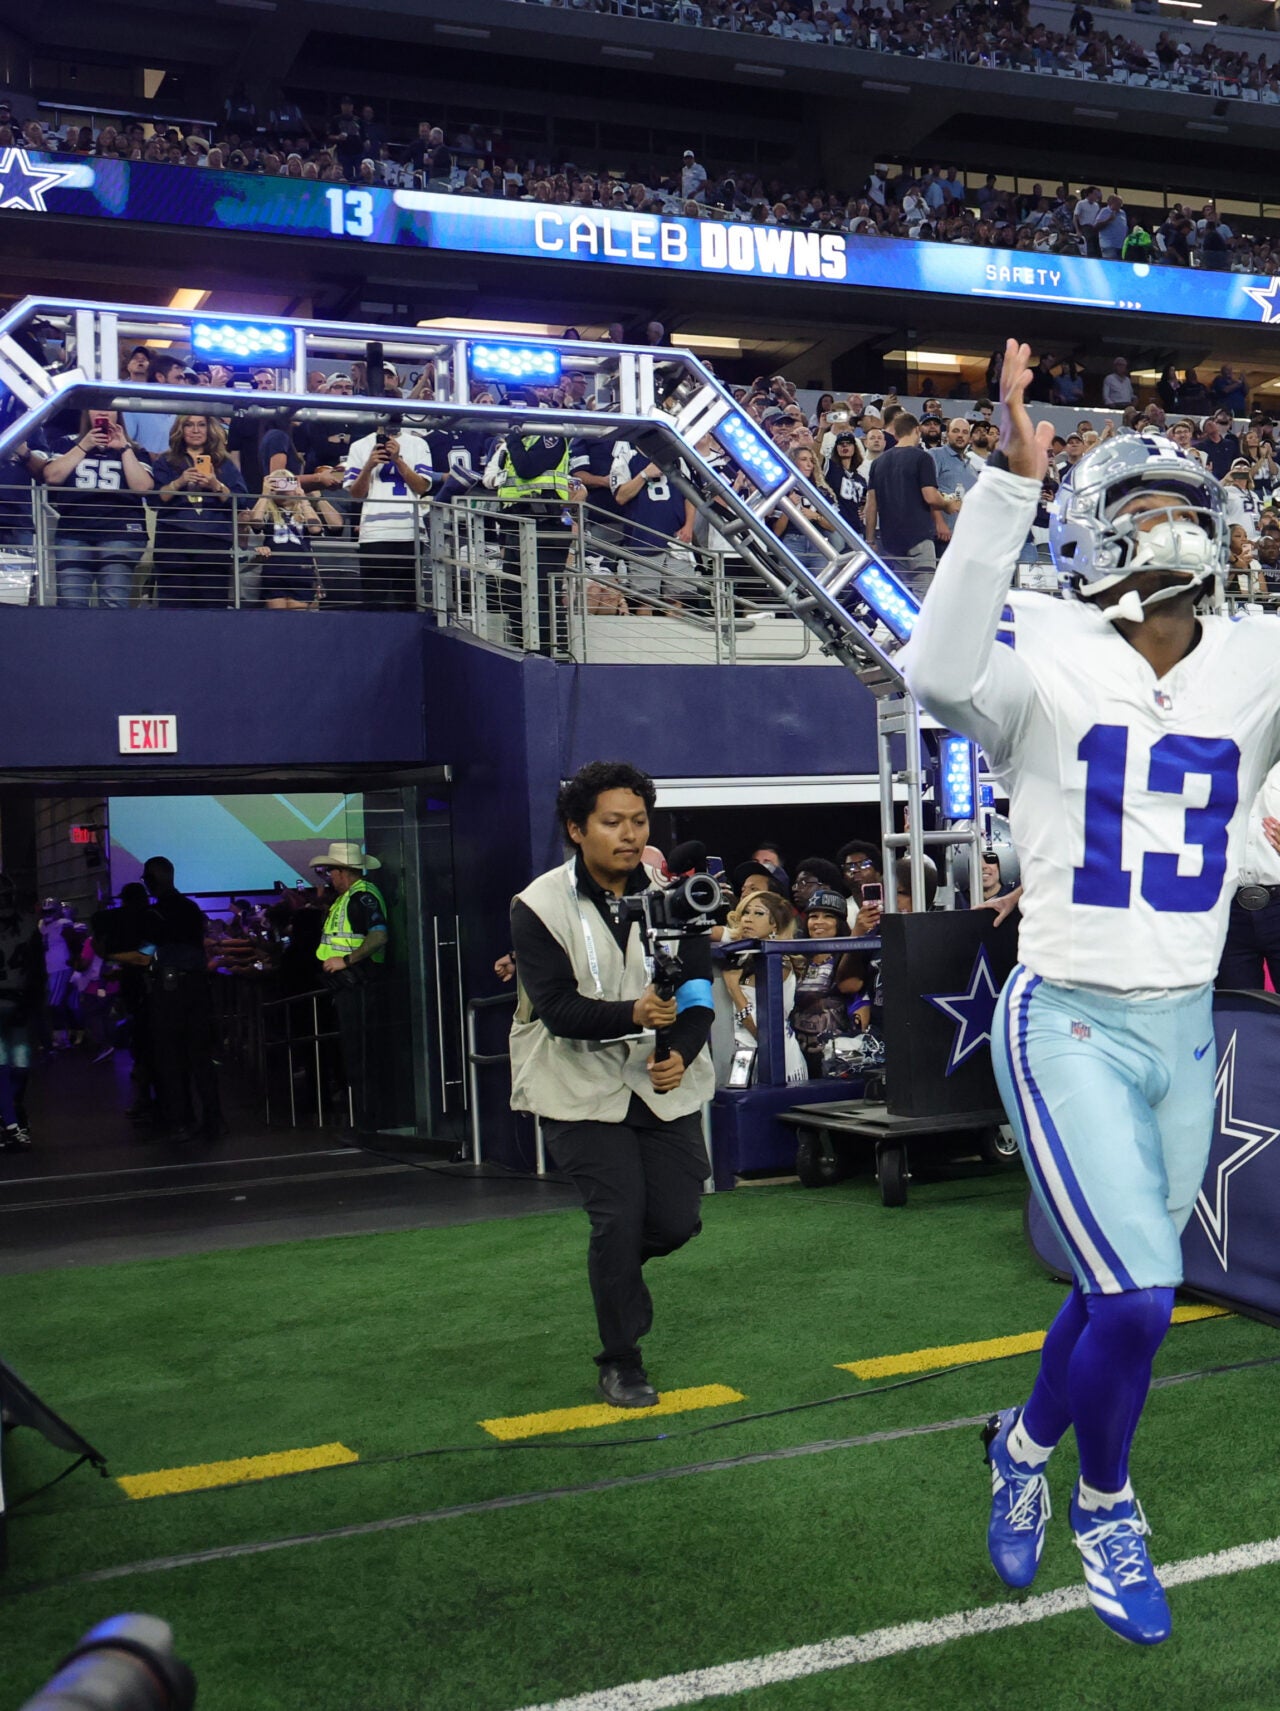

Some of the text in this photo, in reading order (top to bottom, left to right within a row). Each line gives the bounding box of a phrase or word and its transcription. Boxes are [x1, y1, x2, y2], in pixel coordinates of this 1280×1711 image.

[325, 188, 374, 237] 13
[534, 211, 847, 280] CALEB DOWNS
[985, 264, 1061, 287] SAFETY
[76, 459, 122, 490] 55
[378, 459, 408, 496] 4
[647, 474, 671, 501] 8
[129, 719, 169, 749] EXIT
[1072, 723, 1241, 912] 13
